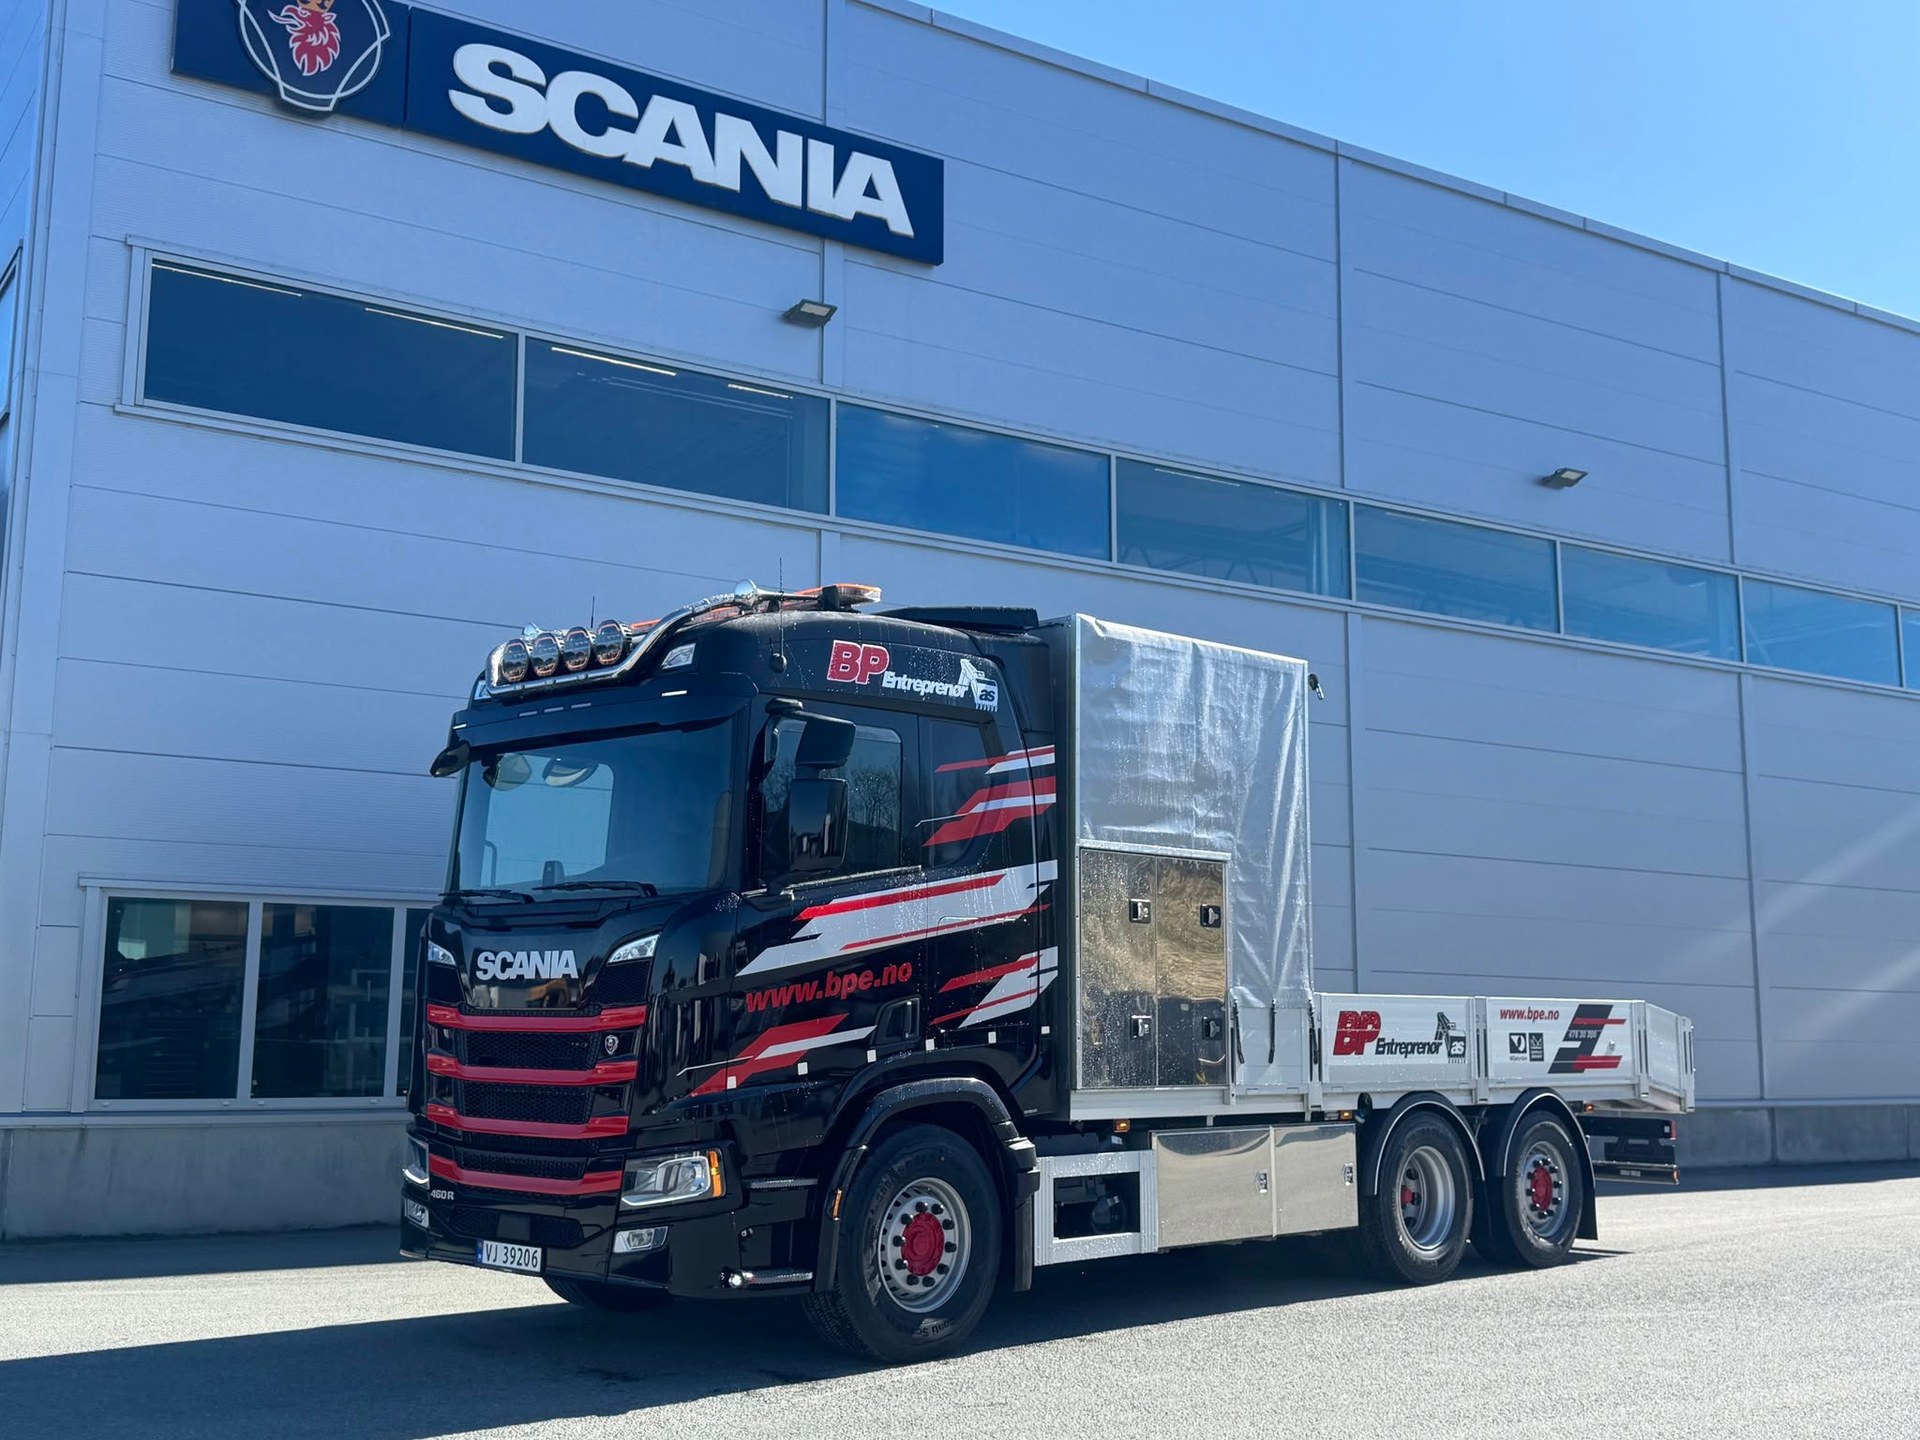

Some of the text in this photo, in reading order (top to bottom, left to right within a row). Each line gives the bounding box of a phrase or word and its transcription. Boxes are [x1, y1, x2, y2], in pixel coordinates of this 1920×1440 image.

[448, 42, 915, 239] SCANIA
[826, 639, 890, 686] BP
[979, 687, 997, 702] as
[475, 949, 580, 981] SCANIA
[745, 961, 914, 1014] www.bpe.no
[1332, 1010, 1382, 1056] BP
[1450, 1040, 1465, 1055] as
[1500, 1006, 1560, 1023] www.bpe.no
[485, 1242, 539, 1269] VJ 39206
